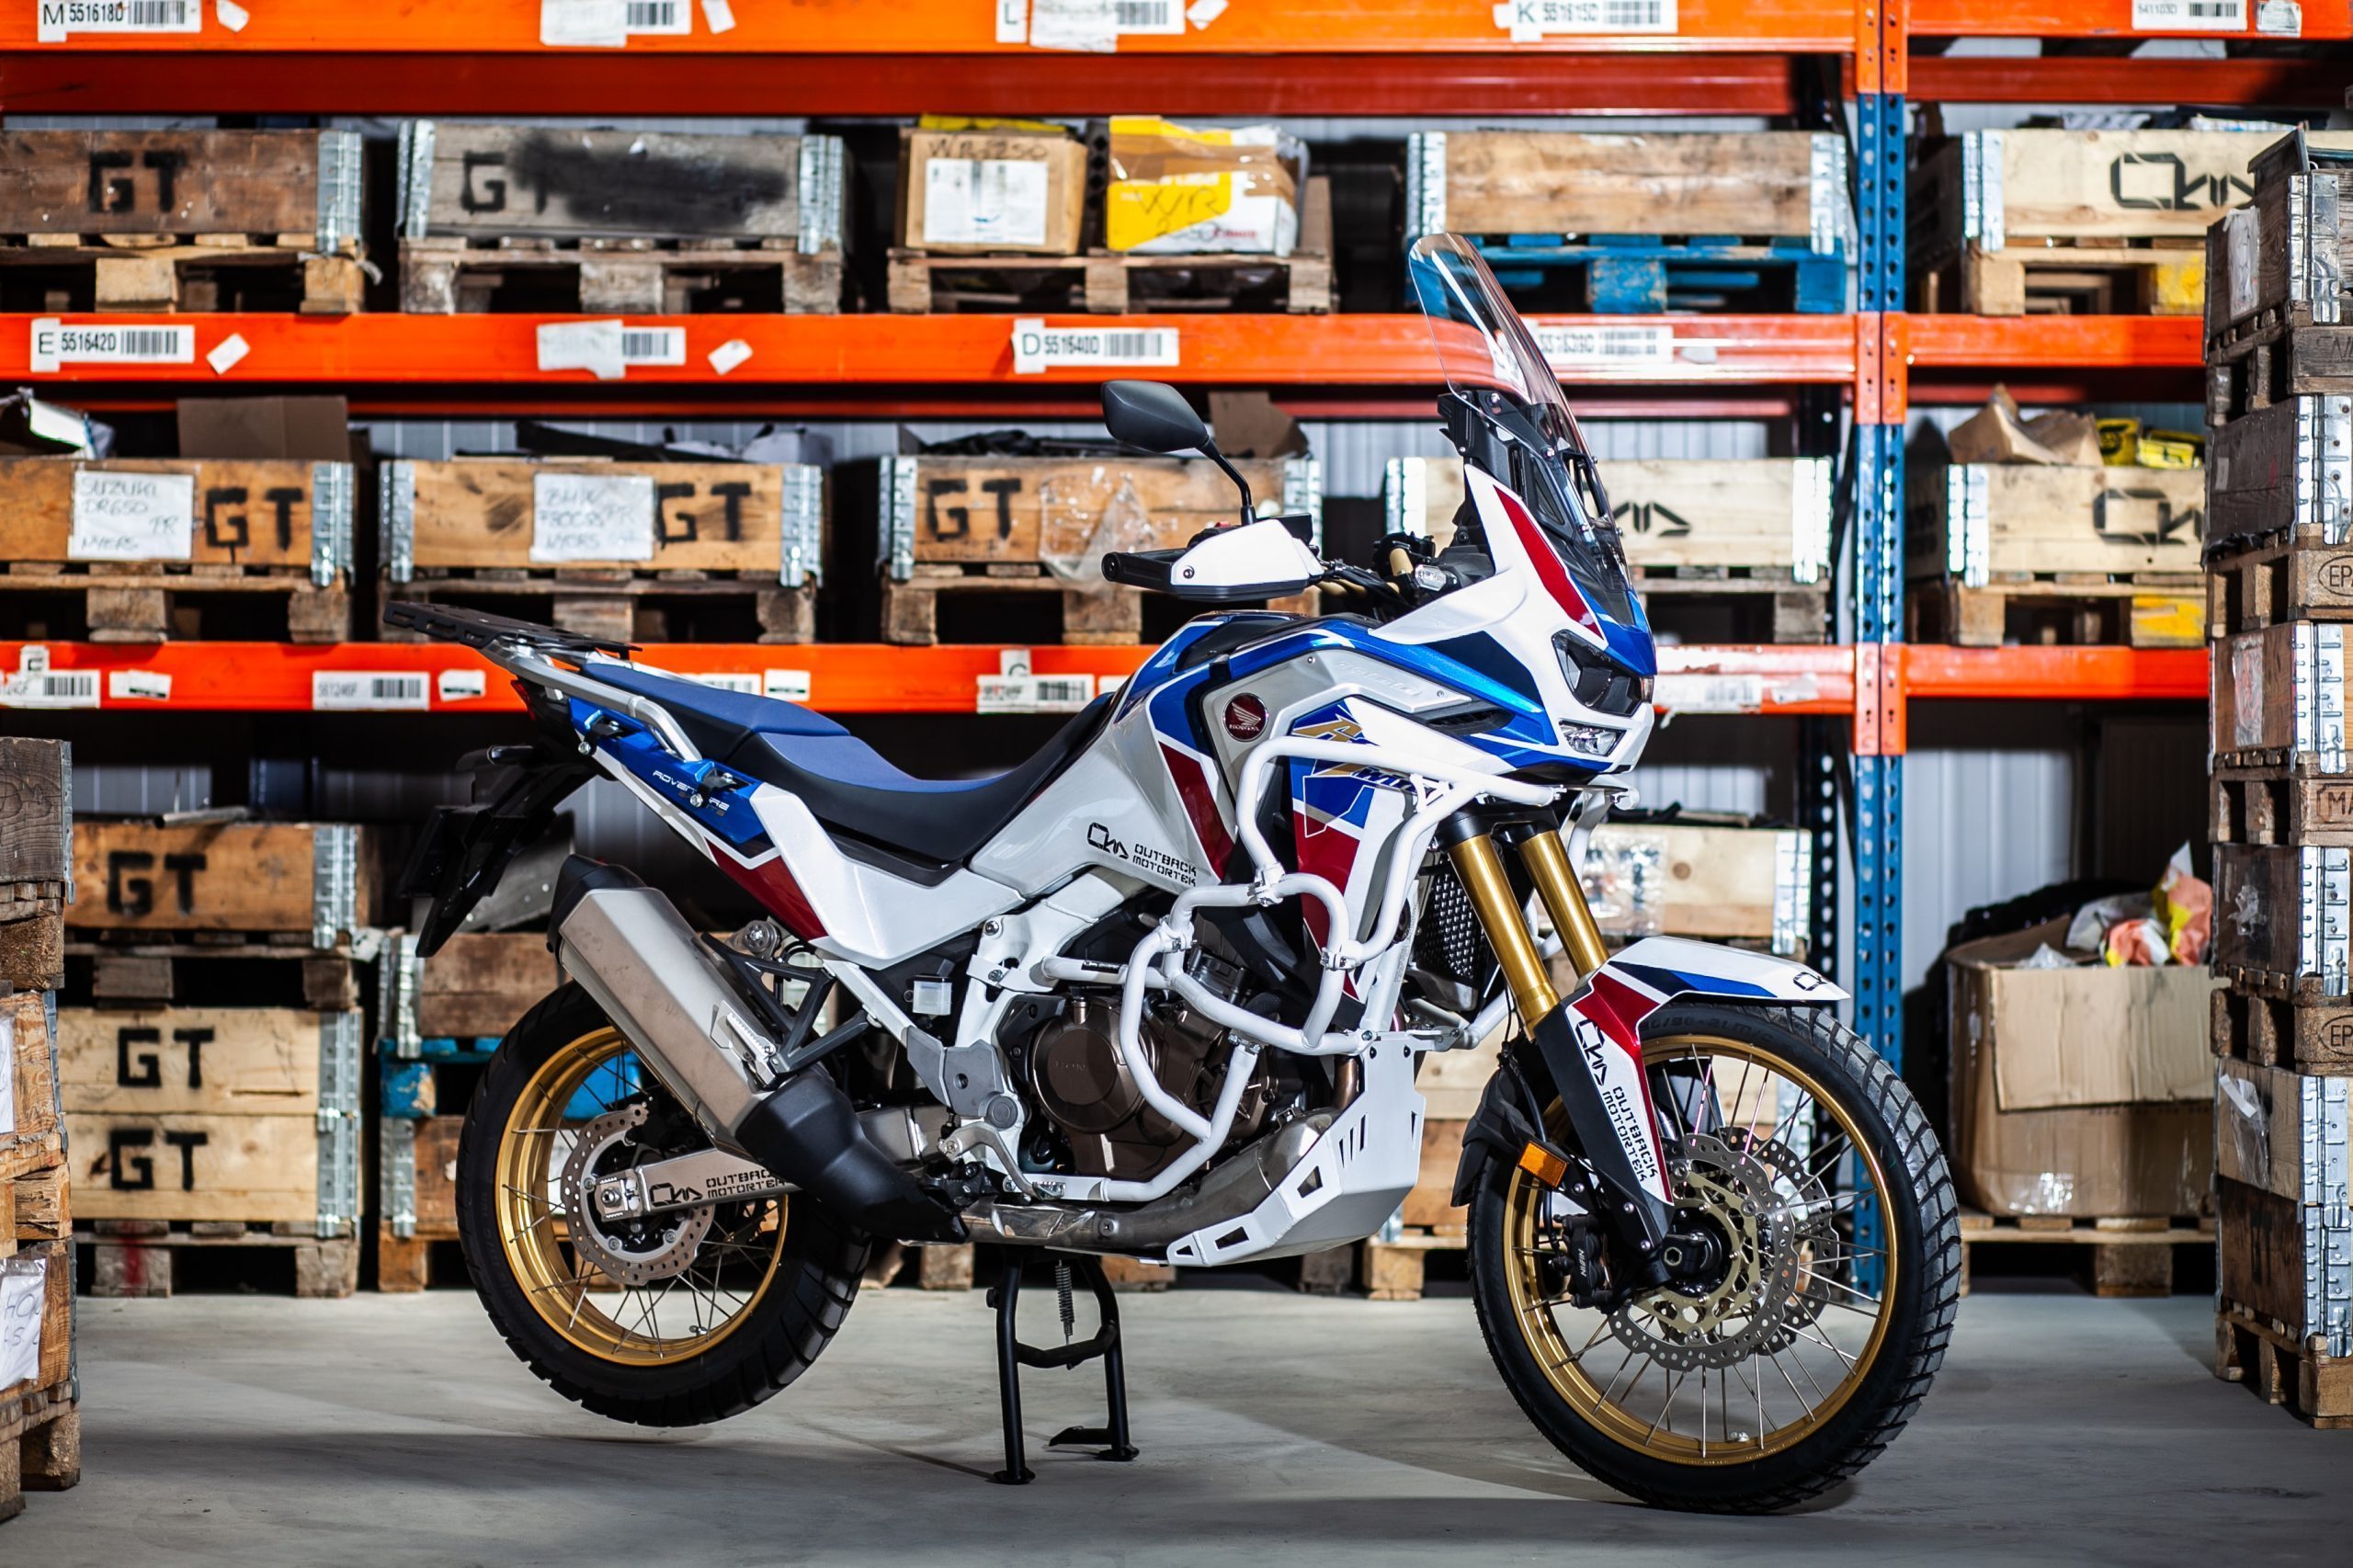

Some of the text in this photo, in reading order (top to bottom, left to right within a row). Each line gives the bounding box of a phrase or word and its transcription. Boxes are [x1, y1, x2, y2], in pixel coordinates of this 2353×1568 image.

[43, 5, 64, 25] M
[1517, 1, 1535, 23] K
[89, 150, 188, 214] GT
[39, 331, 117, 354] E 551642D
[1022, 333, 1041, 356] D
[206, 487, 304, 552] GT
[656, 483, 751, 550] GT
[926, 478, 1022, 541] GT
[108, 850, 208, 917] GT
[1131, 855, 1196, 888] MOTORTEK
[1134, 843, 1197, 878] OUTBACK
[118, 1027, 215, 1089] GT
[109, 1129, 209, 1192] GT
[1602, 1090, 1648, 1183] MOTORTEK
[1612, 1085, 1659, 1178] OUTBACK
[706, 1168, 773, 1188] OUTBAC
